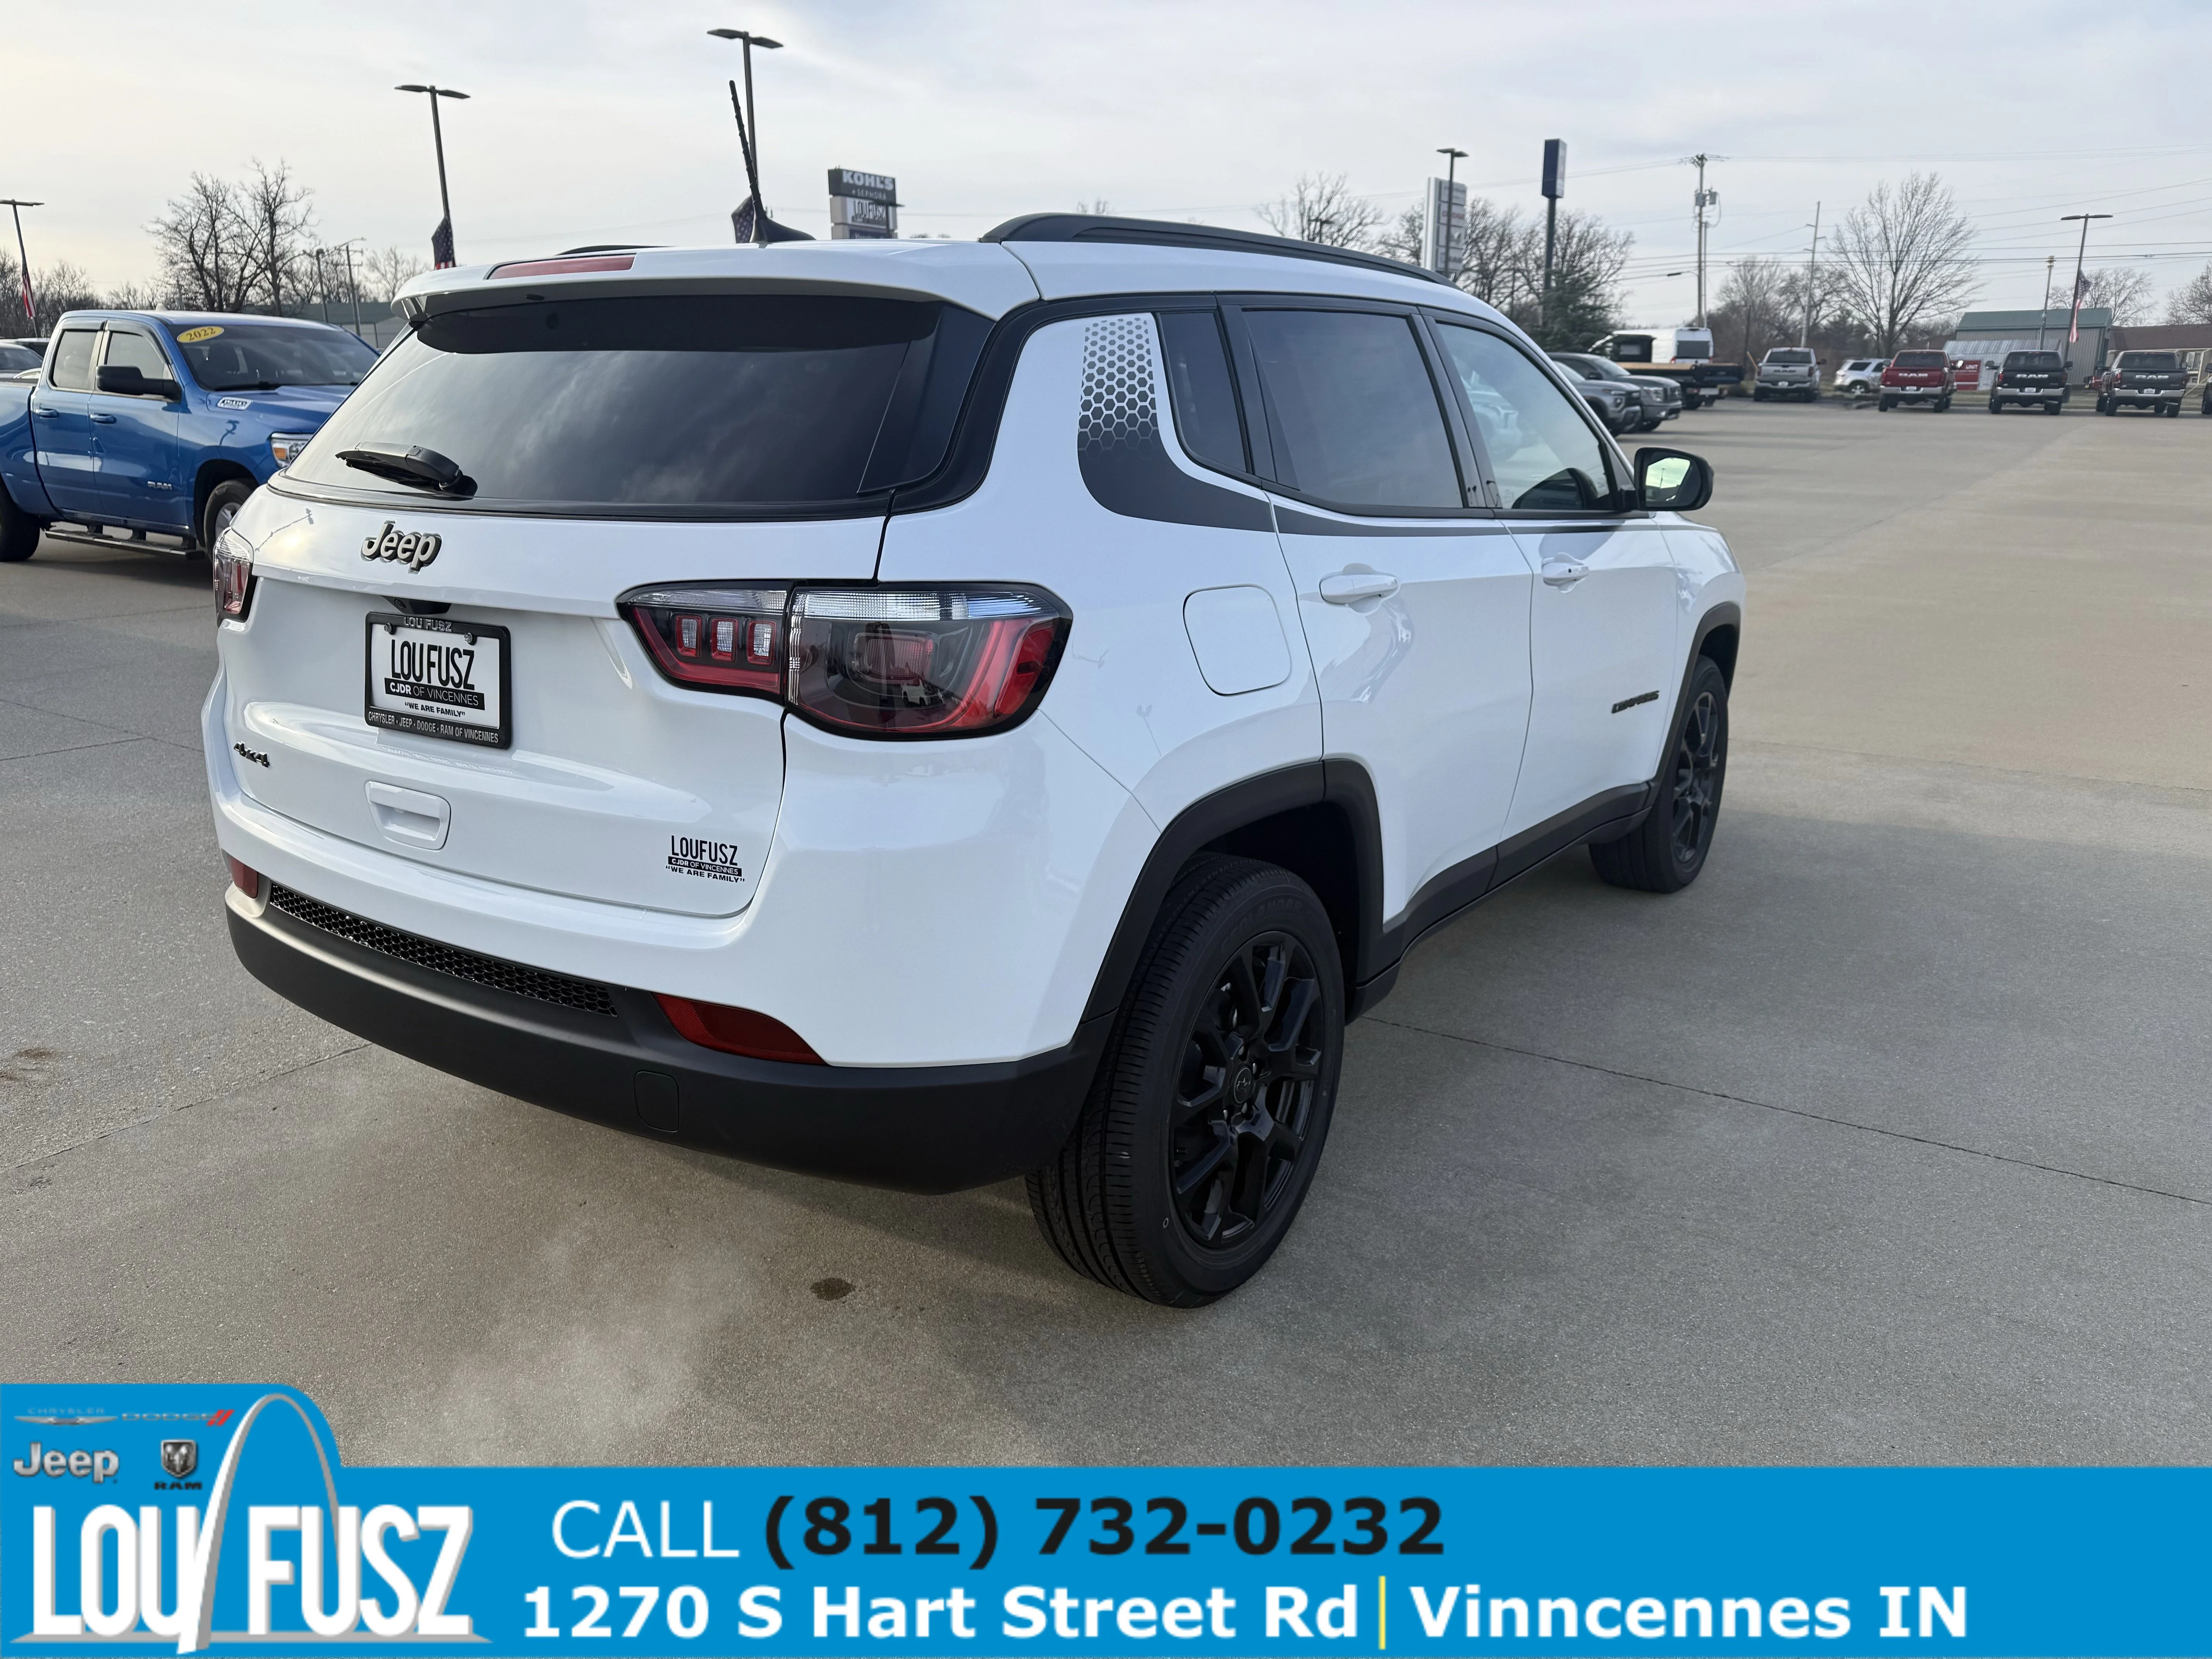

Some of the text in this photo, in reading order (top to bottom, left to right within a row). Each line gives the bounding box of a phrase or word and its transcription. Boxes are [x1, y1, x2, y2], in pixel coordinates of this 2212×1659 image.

[842, 170, 894, 191] KOHL'S
[186, 327, 216, 341] 2022
[148, 481, 173, 491] RAM
[361, 522, 442, 571] Jeep
[404, 617, 452, 632] LOU FUSZ
[392, 639, 474, 690] LOU FUSZ
[390, 682, 479, 706] CJDR OF VINCENNES
[369, 711, 498, 743] CHRYSLER JEEP DODGE RAM OF VINCENNES
[672, 859, 689, 867] CJDR
[701, 863, 738, 875] VINCENNES
[687, 869, 705, 878] ARE
